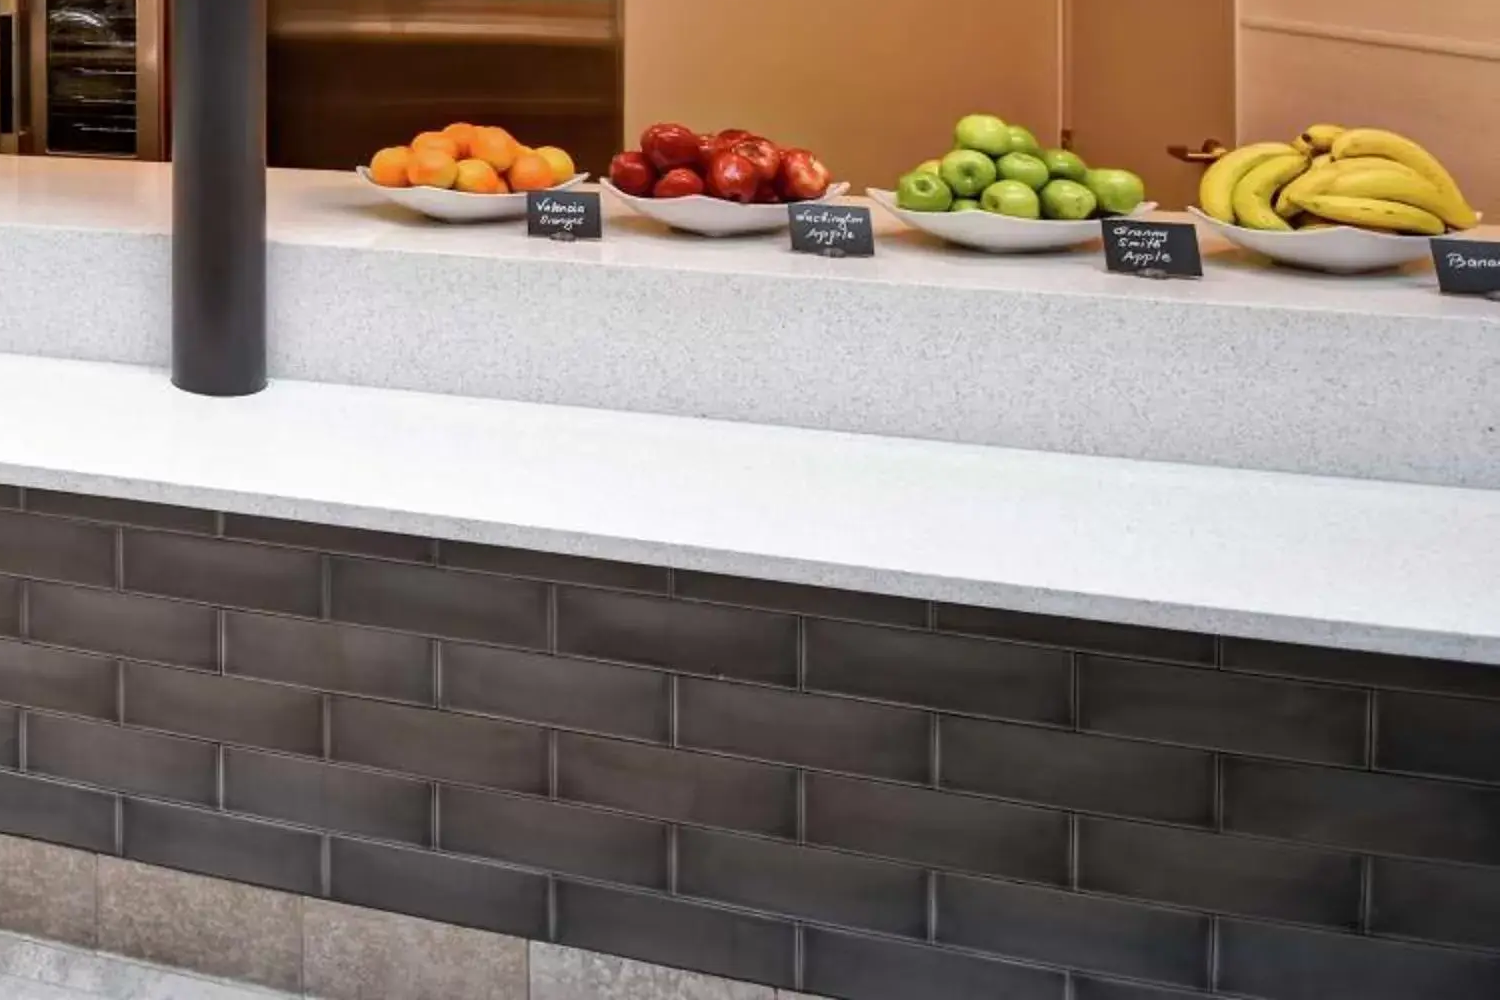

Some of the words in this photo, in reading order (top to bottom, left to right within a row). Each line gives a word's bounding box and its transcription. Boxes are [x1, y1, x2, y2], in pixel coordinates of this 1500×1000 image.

[536, 197, 585, 213] Valencia
[1113, 226, 1169, 242] Granny
[1118, 237, 1161, 249] Smith
[1122, 251, 1172, 266] Apple
[1446, 252, 1500, 269] Bana
